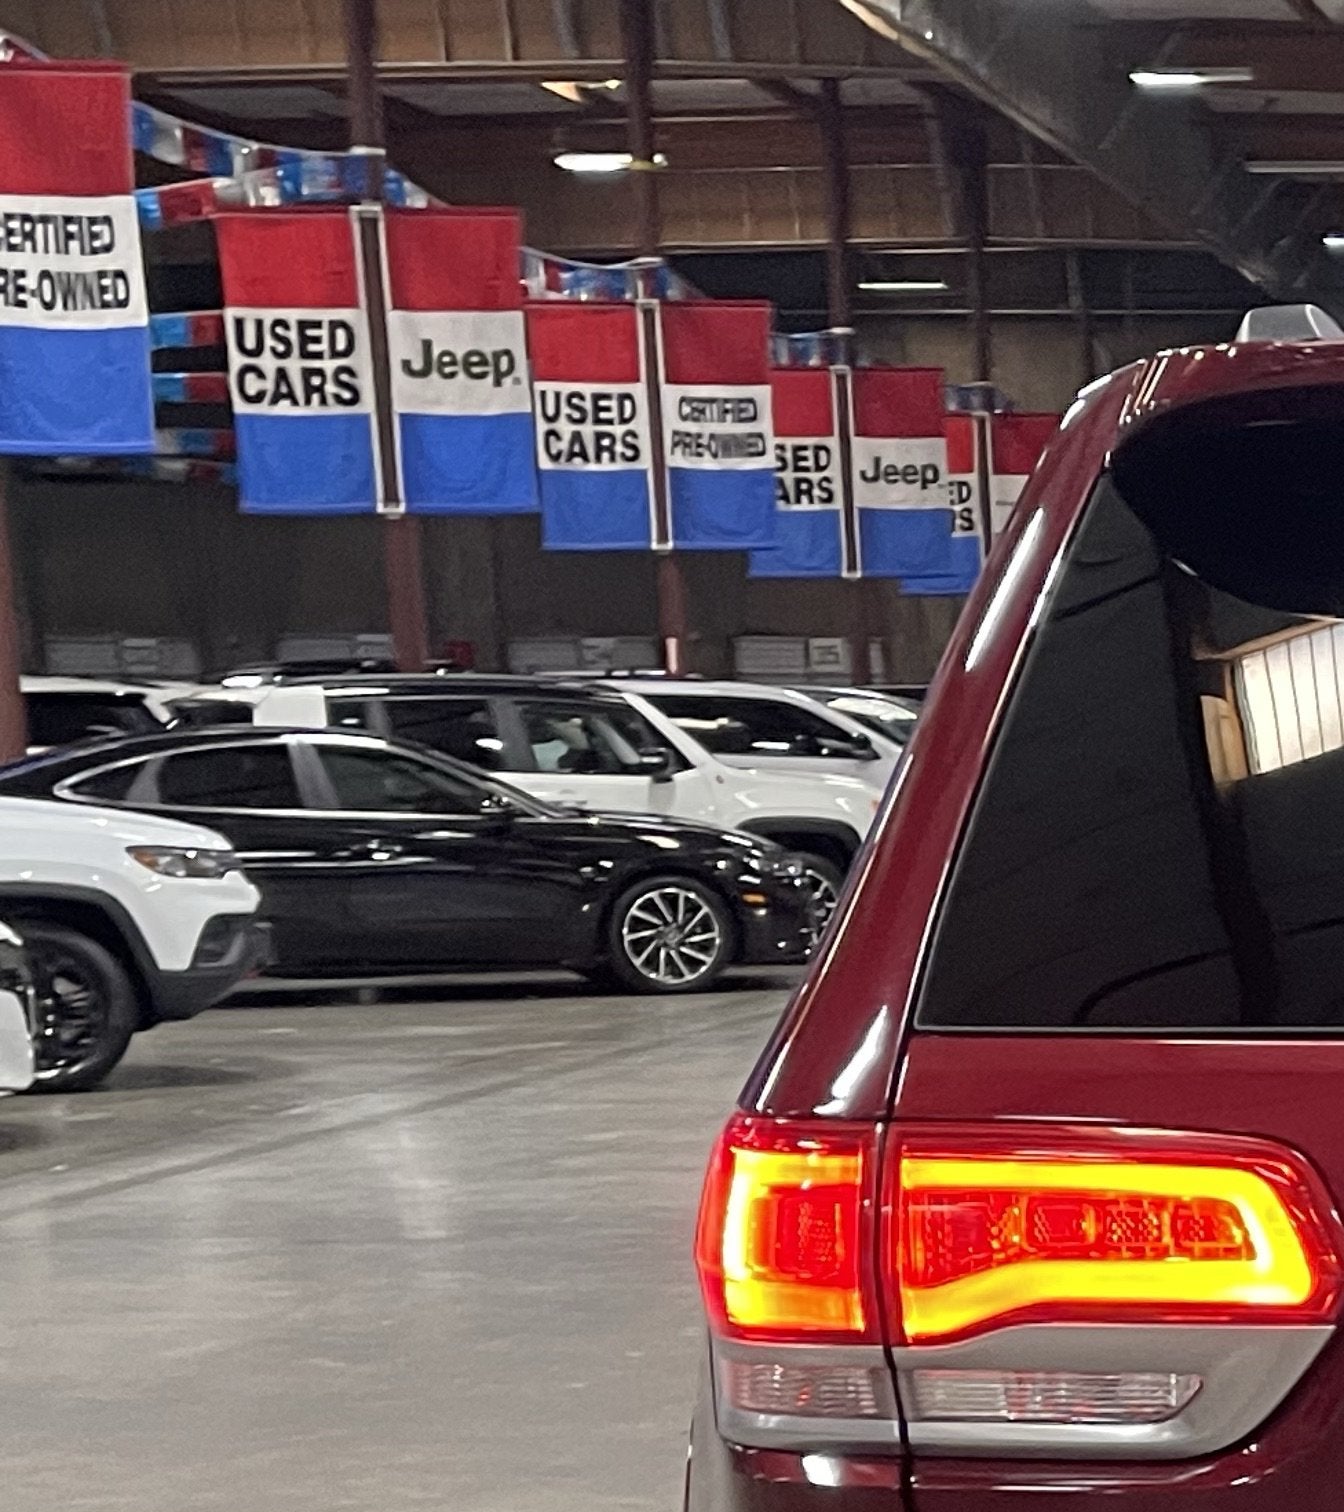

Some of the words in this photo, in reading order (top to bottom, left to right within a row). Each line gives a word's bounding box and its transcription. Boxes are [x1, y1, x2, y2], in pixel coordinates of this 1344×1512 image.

[0, 212, 115, 256] ERTIFIED
[0, 268, 130, 311] RE-OWNED
[233, 318, 355, 360] USED
[401, 339, 516, 386] Jeep
[236, 365, 361, 407] CARS
[540, 390, 637, 425] USED
[678, 396, 758, 423] CERTIFIED
[543, 429, 641, 464] CARS
[670, 430, 766, 459] PRE-OWNED
[774, 443, 832, 473] SED
[776, 476, 834, 505] ARS
[859, 456, 940, 490] Jeep
